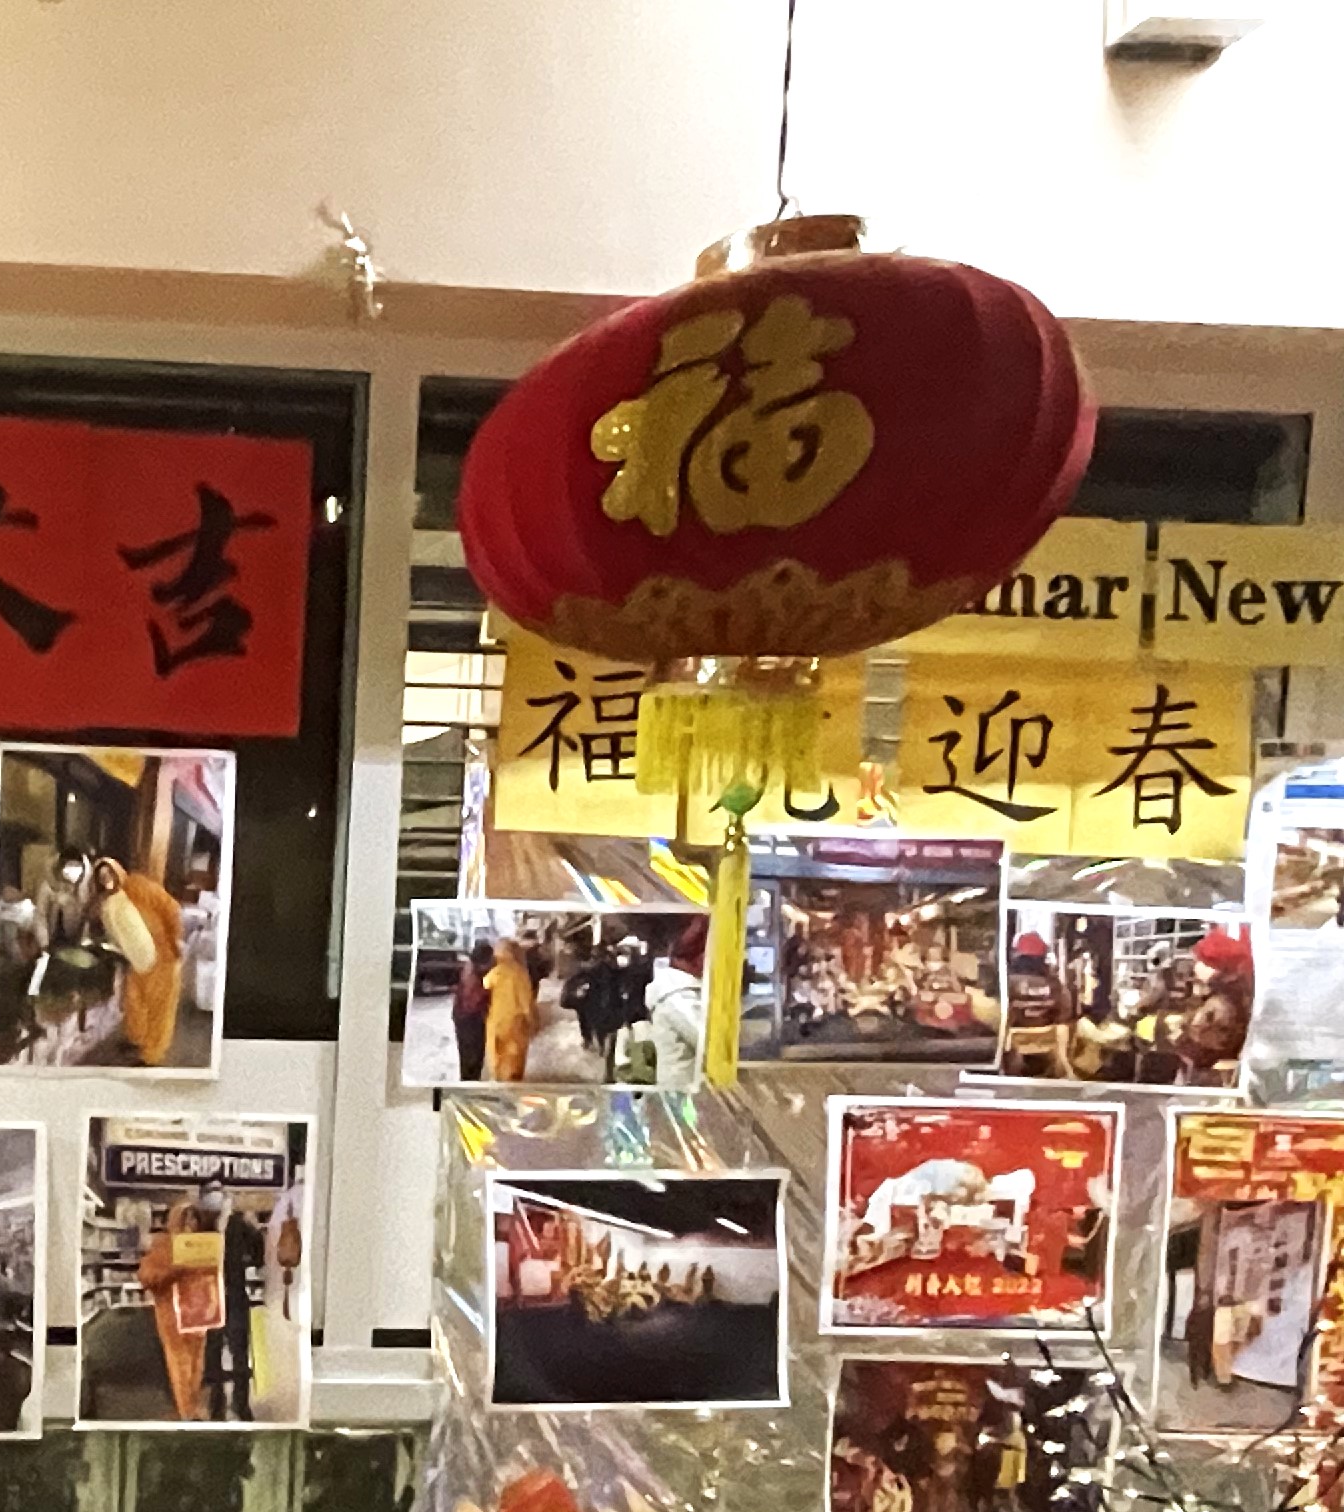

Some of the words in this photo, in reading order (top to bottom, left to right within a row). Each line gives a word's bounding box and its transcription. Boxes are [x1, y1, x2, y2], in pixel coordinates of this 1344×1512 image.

[591, 294, 875, 536] 福
[973, 573, 1130, 619] nar
[1165, 558, 1344, 625] New
[518, 660, 1237, 836] 福迎春
